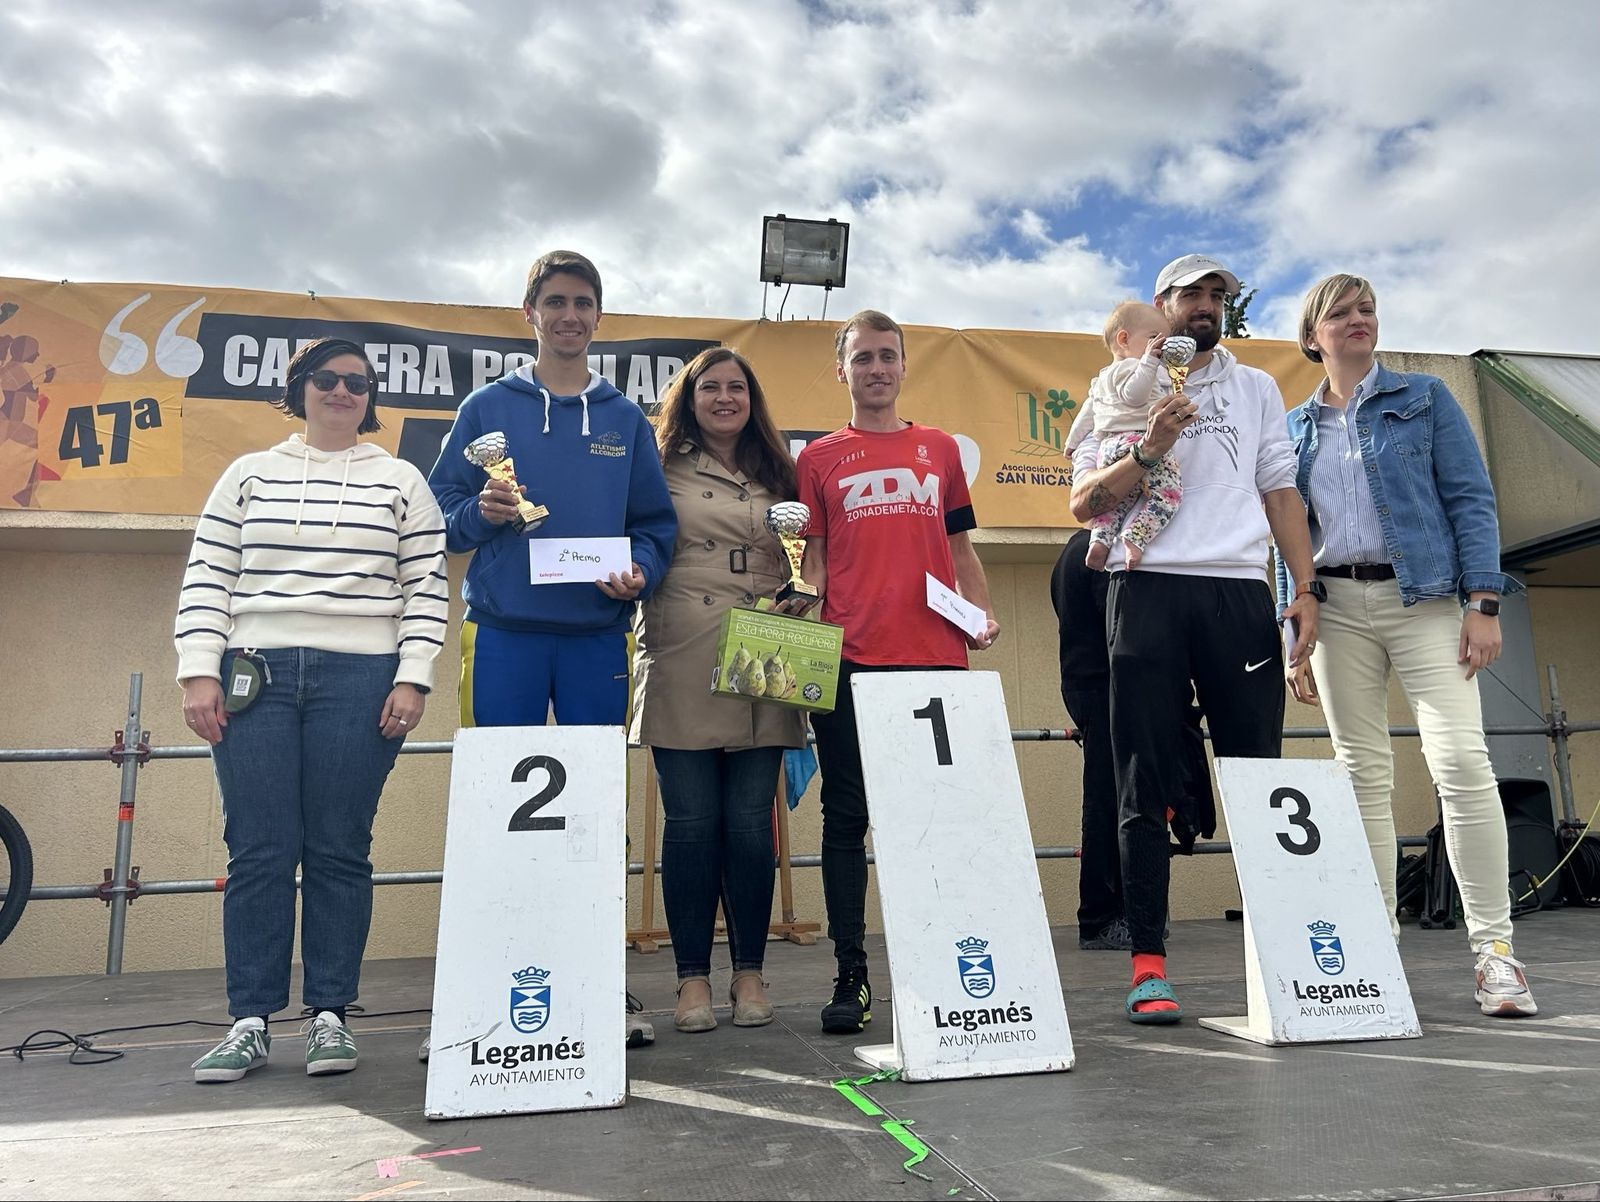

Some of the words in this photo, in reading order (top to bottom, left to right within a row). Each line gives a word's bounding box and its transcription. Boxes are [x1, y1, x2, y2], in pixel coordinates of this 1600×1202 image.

[223, 334, 454, 396] CAERA
[472, 348, 687, 404] PLAR
[1192, 415, 1224, 427] TISMO
[1178, 425, 1239, 439] ADAHONDA
[590, 443, 626, 452] ATLETISMO
[995, 471, 1026, 484] SAN
[1031, 473, 1074, 487] NICAS
[1001, 463, 1050, 473] Asociación
[1052, 466, 1074, 475] Veci
[838, 467, 940, 513] ZDM
[571, 551, 601, 564] Premio
[912, 697, 953, 766] 1
[507, 755, 567, 832] 2
[1269, 787, 1321, 856] 3
[1293, 978, 1381, 1004] Leganés
[933, 1001, 1033, 1033] Leganés
[1299, 1004, 1386, 1018] AYUNTAMIENTO
[938, 1028, 1037, 1048] AYUNTAMIENTO
[470, 1036, 585, 1069] Leganés
[469, 1066, 586, 1087] AYUNTAMIENTO
